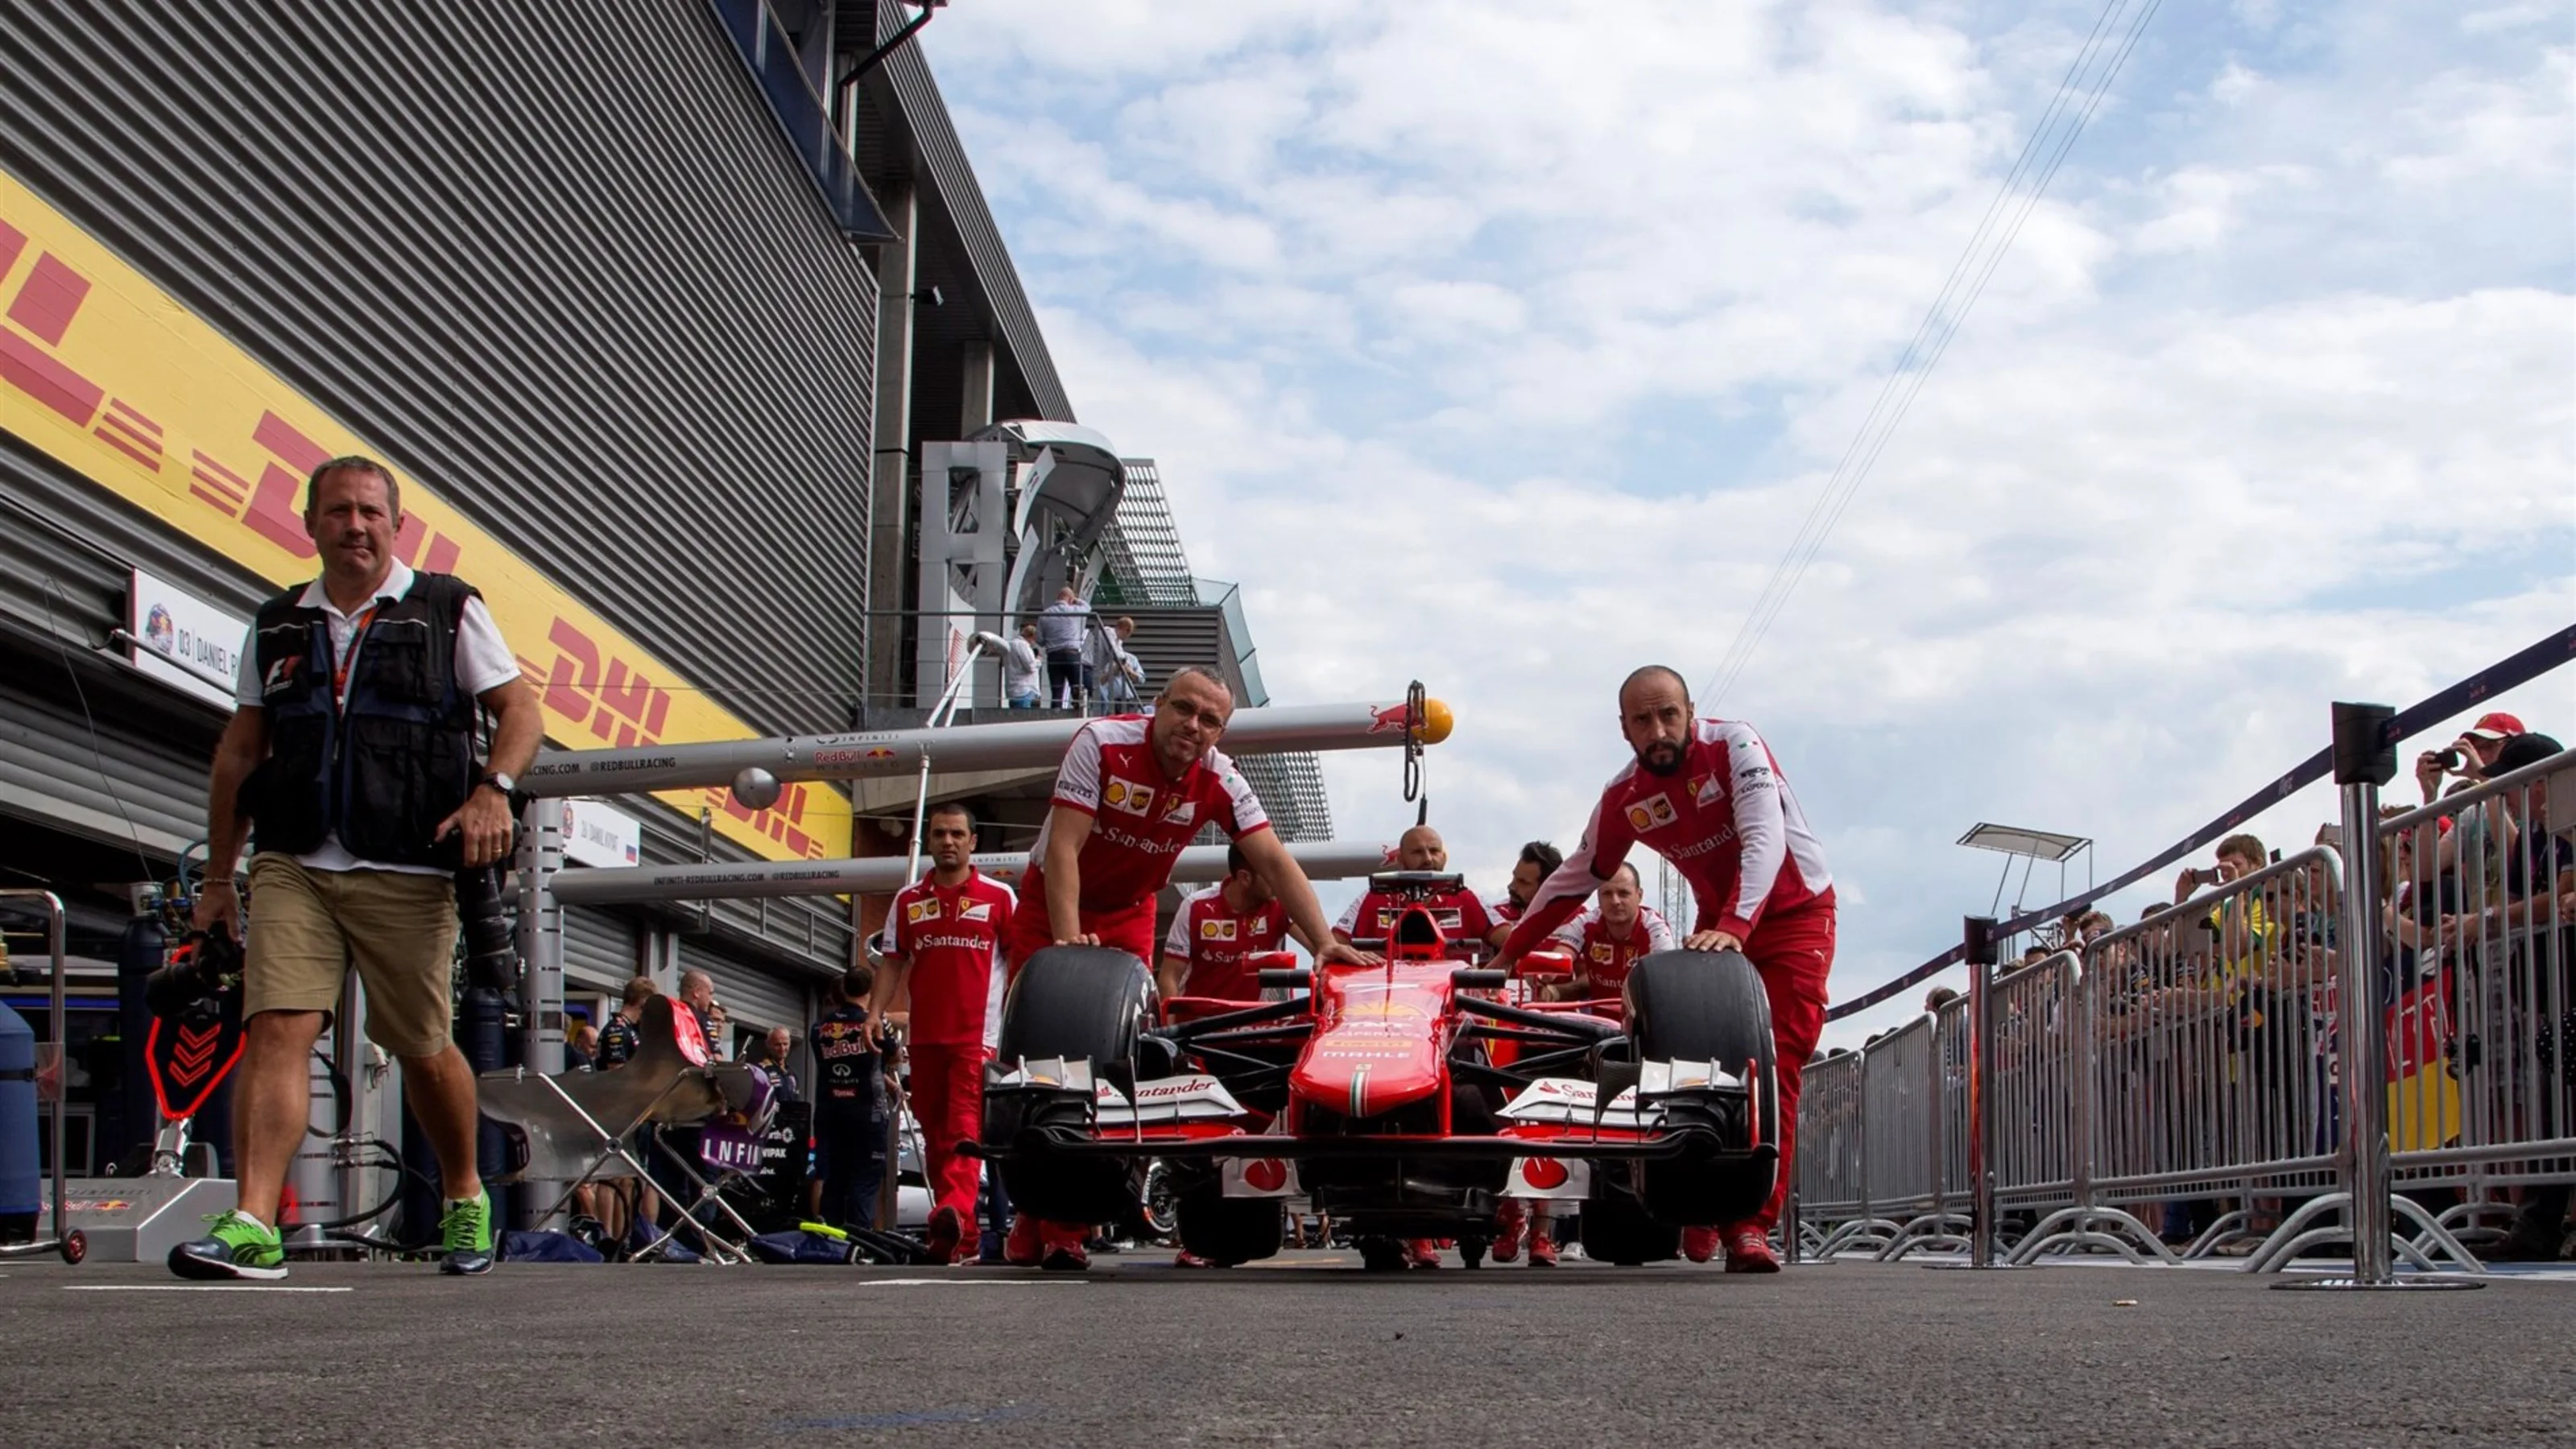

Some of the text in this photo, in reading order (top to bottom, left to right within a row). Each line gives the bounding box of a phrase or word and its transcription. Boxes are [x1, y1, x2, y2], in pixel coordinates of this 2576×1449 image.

[179, 629, 190, 657] 03
[196, 637, 229, 675] DANIEL
[589, 757, 676, 773] @REDBULLRACING
[654, 869, 840, 885] INFINITI-REDBULLRACING.COM @REDBULLRACING
[923, 934, 991, 951] Santander
[1322, 1051, 1411, 1059] MAHLE
